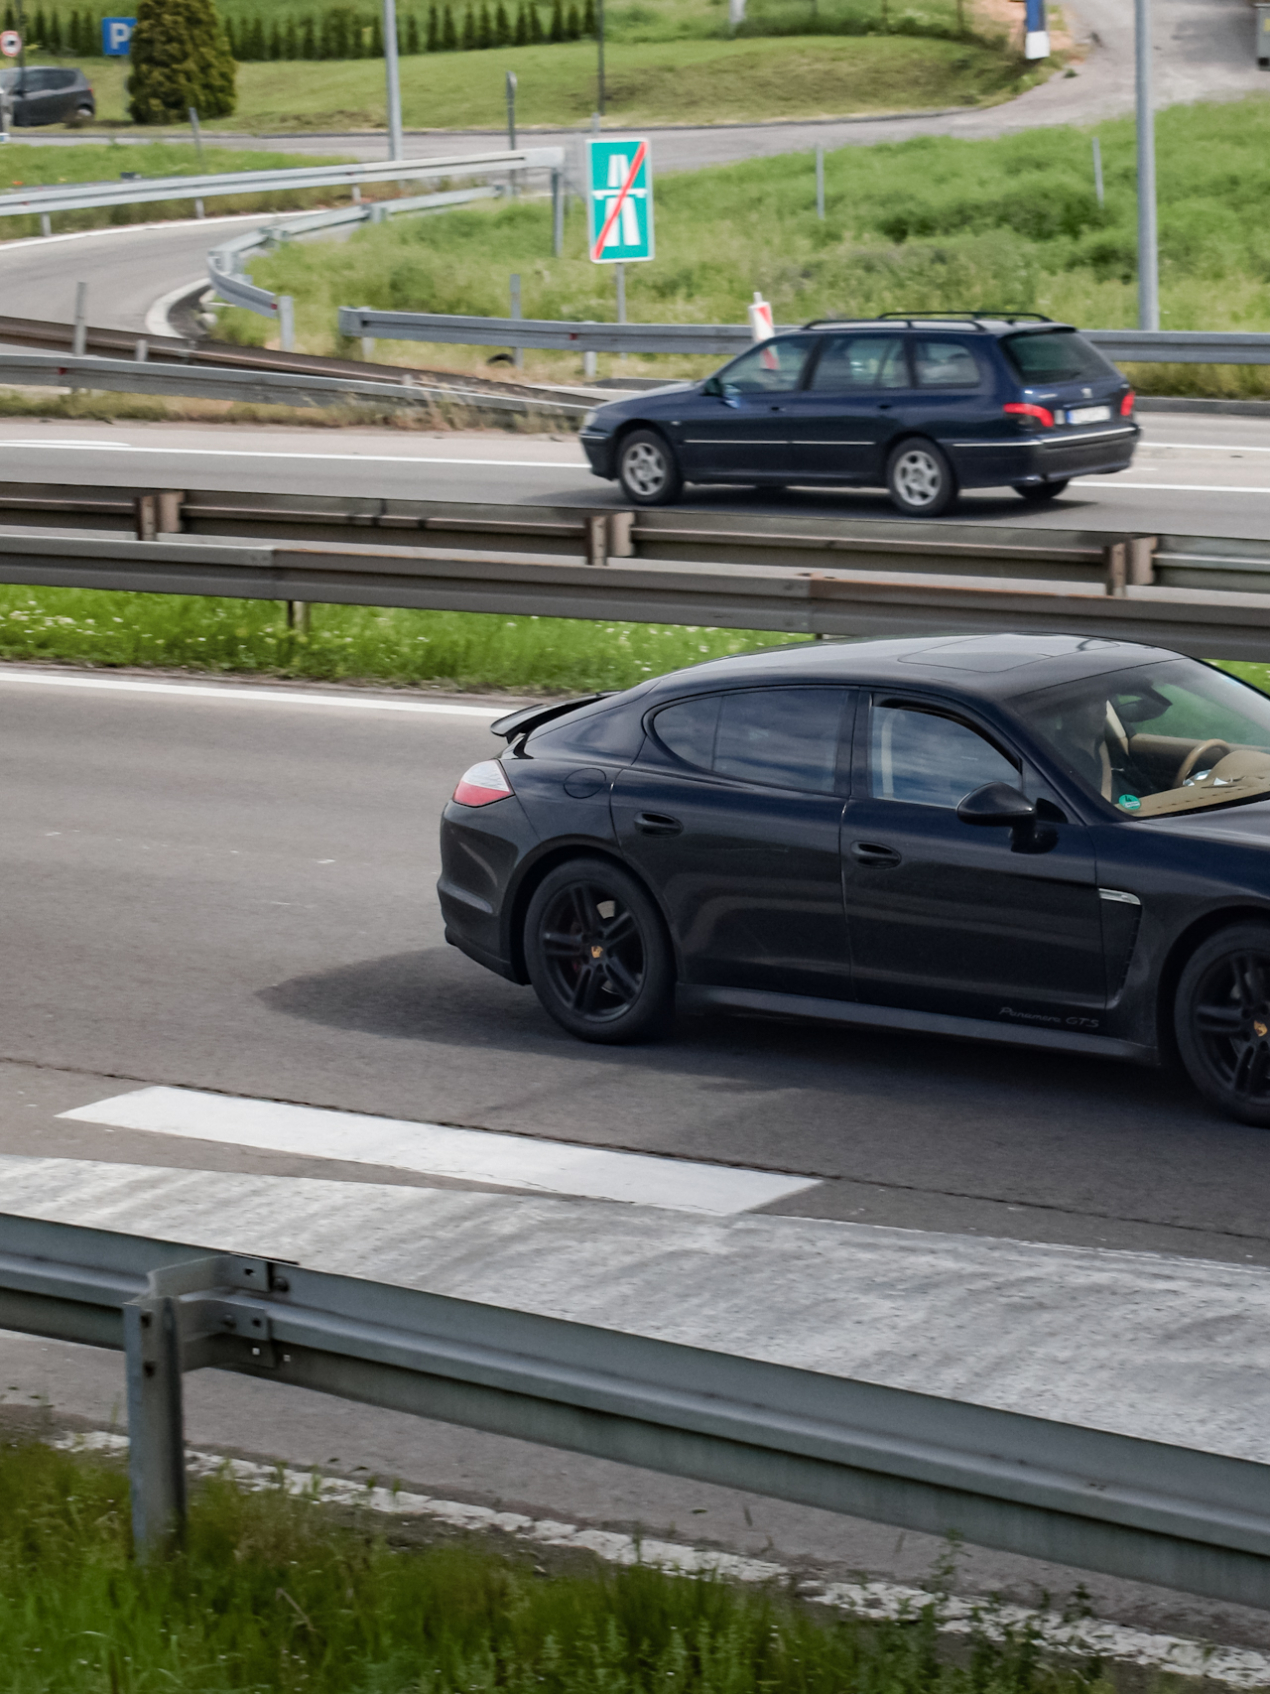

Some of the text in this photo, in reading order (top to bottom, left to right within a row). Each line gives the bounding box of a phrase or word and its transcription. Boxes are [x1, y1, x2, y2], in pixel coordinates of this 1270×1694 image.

[111, 23, 131, 49] P
[999, 1007, 1100, 1028] Panamera GTS
